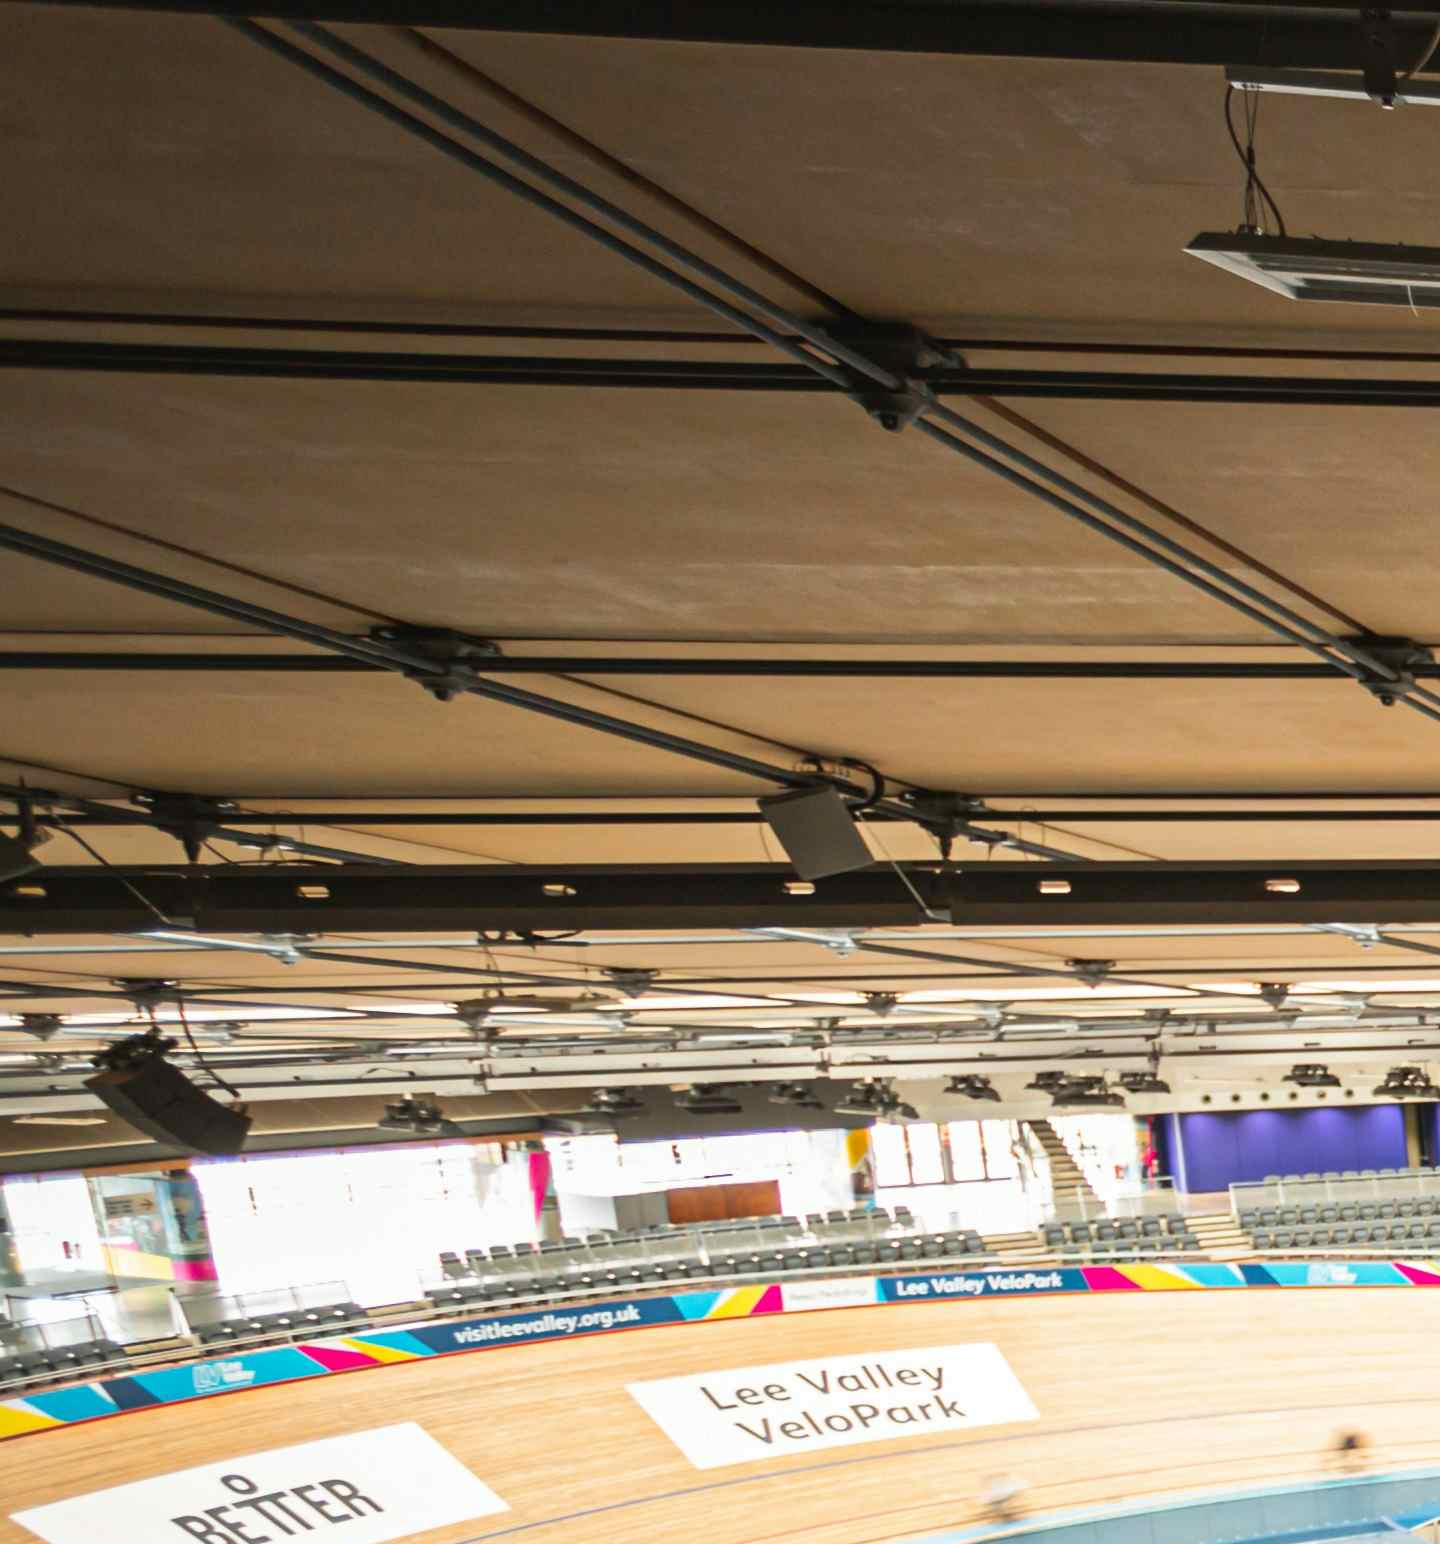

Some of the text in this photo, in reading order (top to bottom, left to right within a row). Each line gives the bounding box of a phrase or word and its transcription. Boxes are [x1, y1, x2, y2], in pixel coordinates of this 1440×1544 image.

[896, 1272, 1062, 1297] Lee Valley VeloPark
[453, 1304, 640, 1344] visitleevalley.org.uk
[699, 1363, 946, 1411] Lee Valley
[734, 1394, 967, 1446] VeloPark
